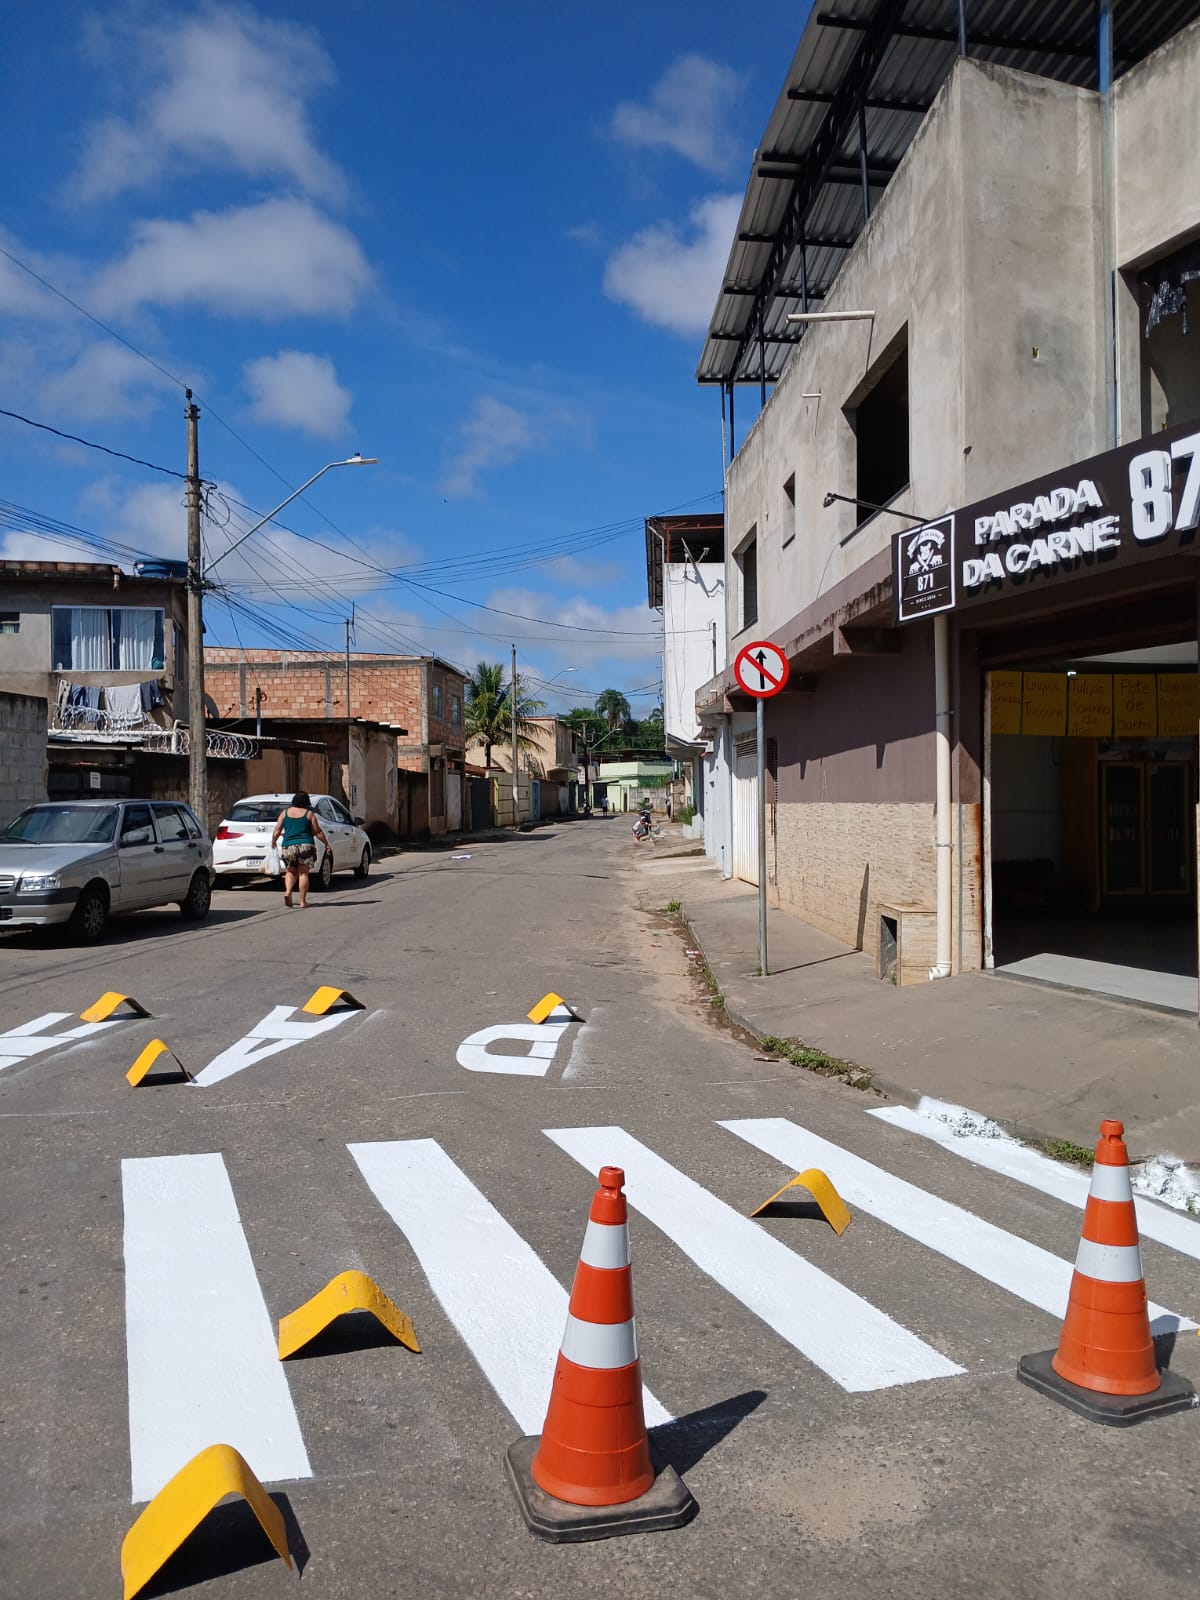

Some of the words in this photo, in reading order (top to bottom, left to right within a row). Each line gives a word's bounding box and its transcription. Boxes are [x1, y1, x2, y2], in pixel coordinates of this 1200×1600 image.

[975, 480, 1103, 545] PARADA
[1129, 433, 1200, 540] 87
[917, 573, 934, 591] 871
[962, 553, 1005, 587] DA
[1005, 515, 1121, 573] CARNE
